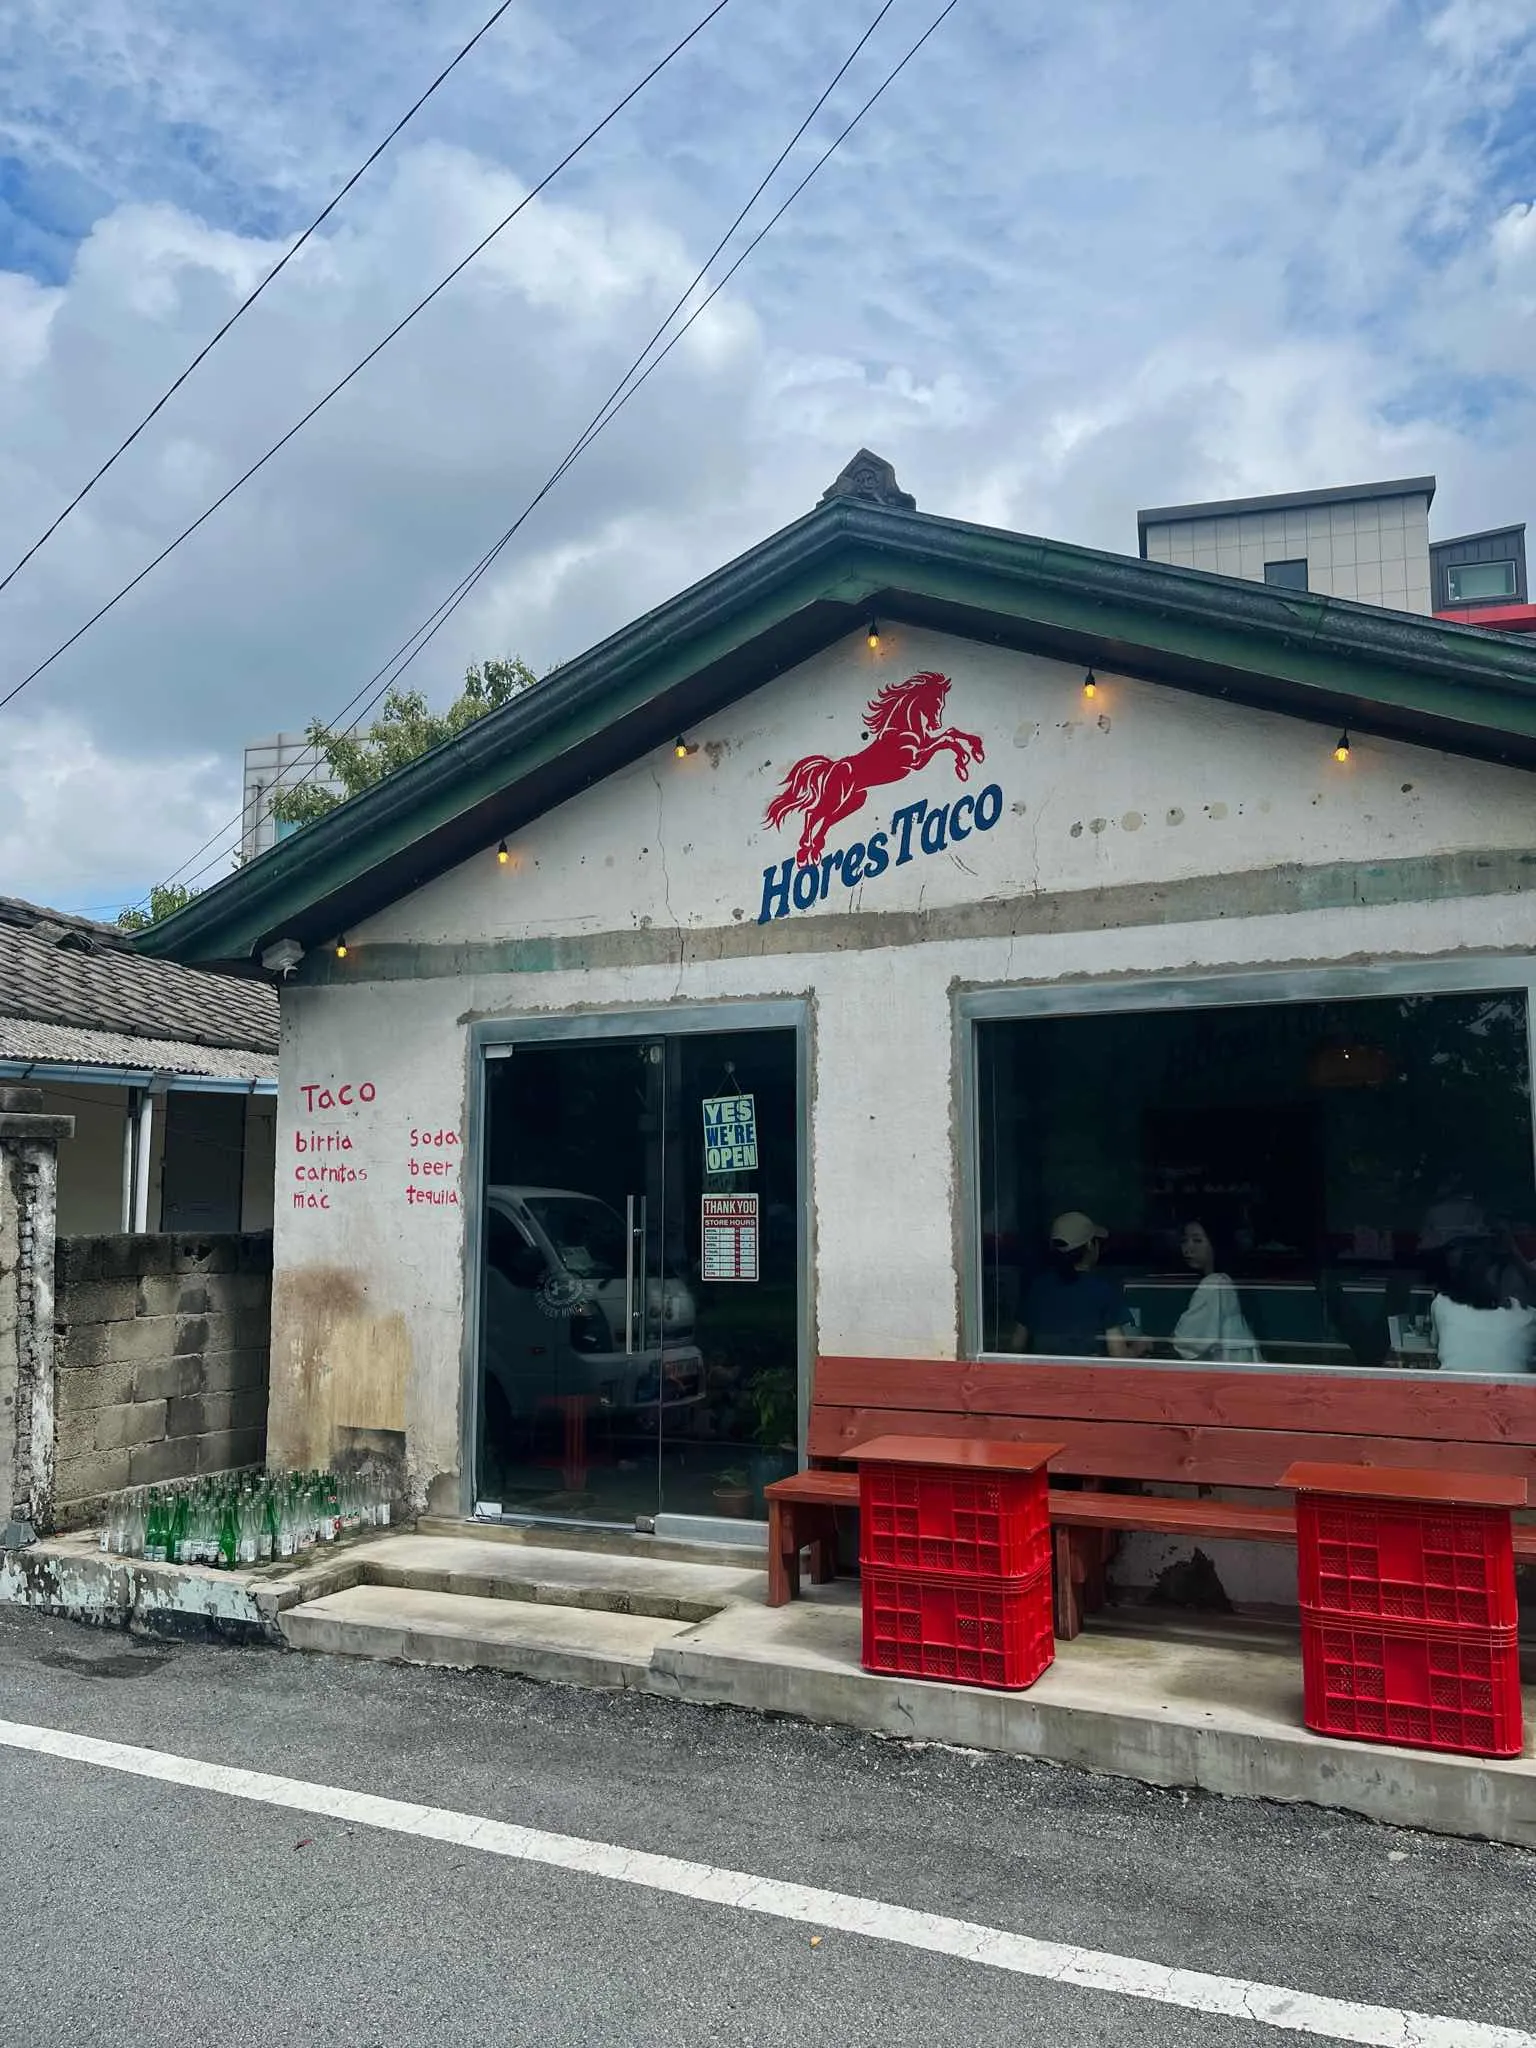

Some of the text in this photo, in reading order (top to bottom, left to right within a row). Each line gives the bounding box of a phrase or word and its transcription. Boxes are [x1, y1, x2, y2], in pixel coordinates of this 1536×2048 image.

[705, 1100, 752, 1124] YES
[295, 1131, 353, 1152] birria
[706, 1123, 755, 1147] WE'RE
[409, 1158, 453, 1175] beer
[708, 1145, 756, 1170] OPEN
[293, 1192, 330, 1209] mac
[406, 1184, 458, 1204] tequila
[704, 1200, 756, 1214] THANK YOU
